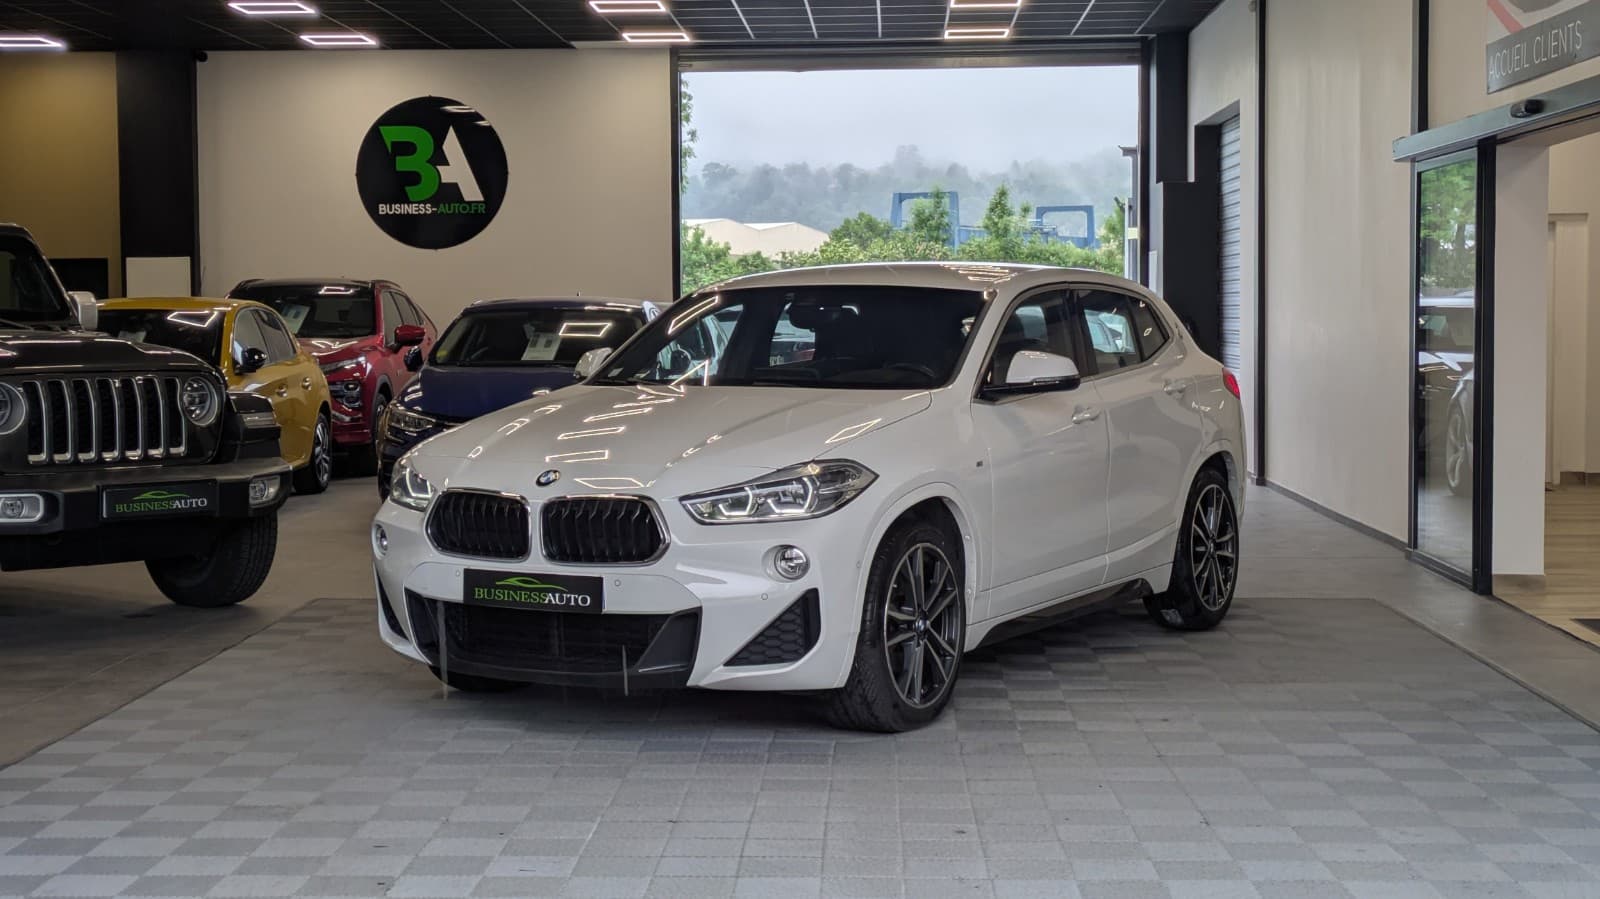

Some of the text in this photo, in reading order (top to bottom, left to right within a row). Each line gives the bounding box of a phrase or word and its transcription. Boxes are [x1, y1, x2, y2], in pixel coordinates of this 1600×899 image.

[1489, 20, 1582, 81] ACCUEIL CLIENTS
[378, 203, 486, 215] BUSINESS-AUTO.FR
